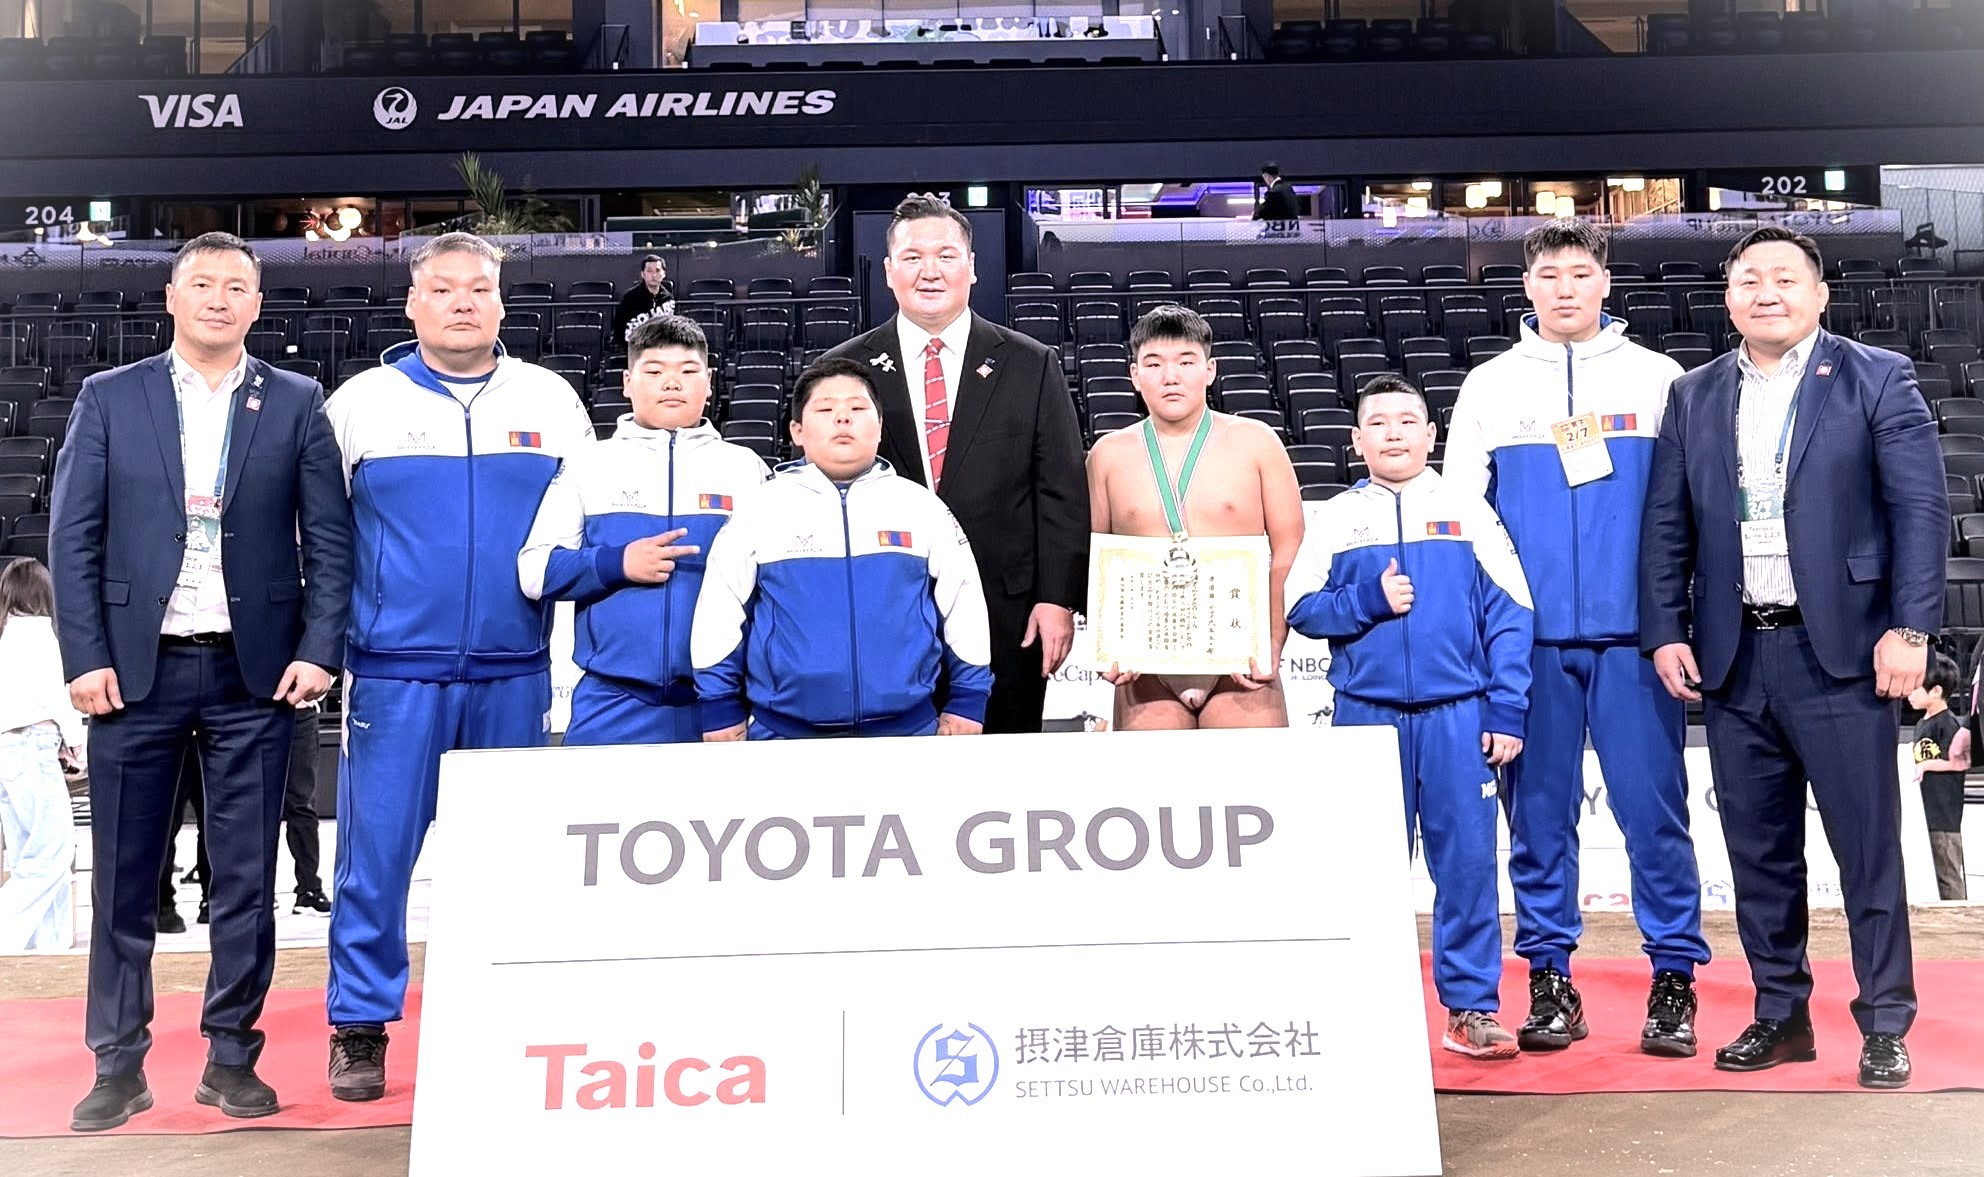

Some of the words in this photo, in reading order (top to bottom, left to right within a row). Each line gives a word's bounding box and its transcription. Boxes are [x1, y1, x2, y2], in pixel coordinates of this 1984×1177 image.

[138, 93, 244, 128] VISA
[437, 94, 598, 120] JAPAN
[604, 90, 837, 118] AIRLINES
[1761, 175, 1808, 196] 202
[25, 205, 74, 226] 204
[566, 813, 924, 887] TOYOTA
[955, 804, 1275, 875] GROUP
[1014, 1020, 1322, 1065] 摂津倉庫株式会社
[524, 1041, 767, 1111] Taica
[1015, 1079, 1093, 1099] SETTSU
[1100, 1075, 1231, 1096] WAREHOUSE
[1239, 1074, 1313, 1095] Co.,Ltd.
